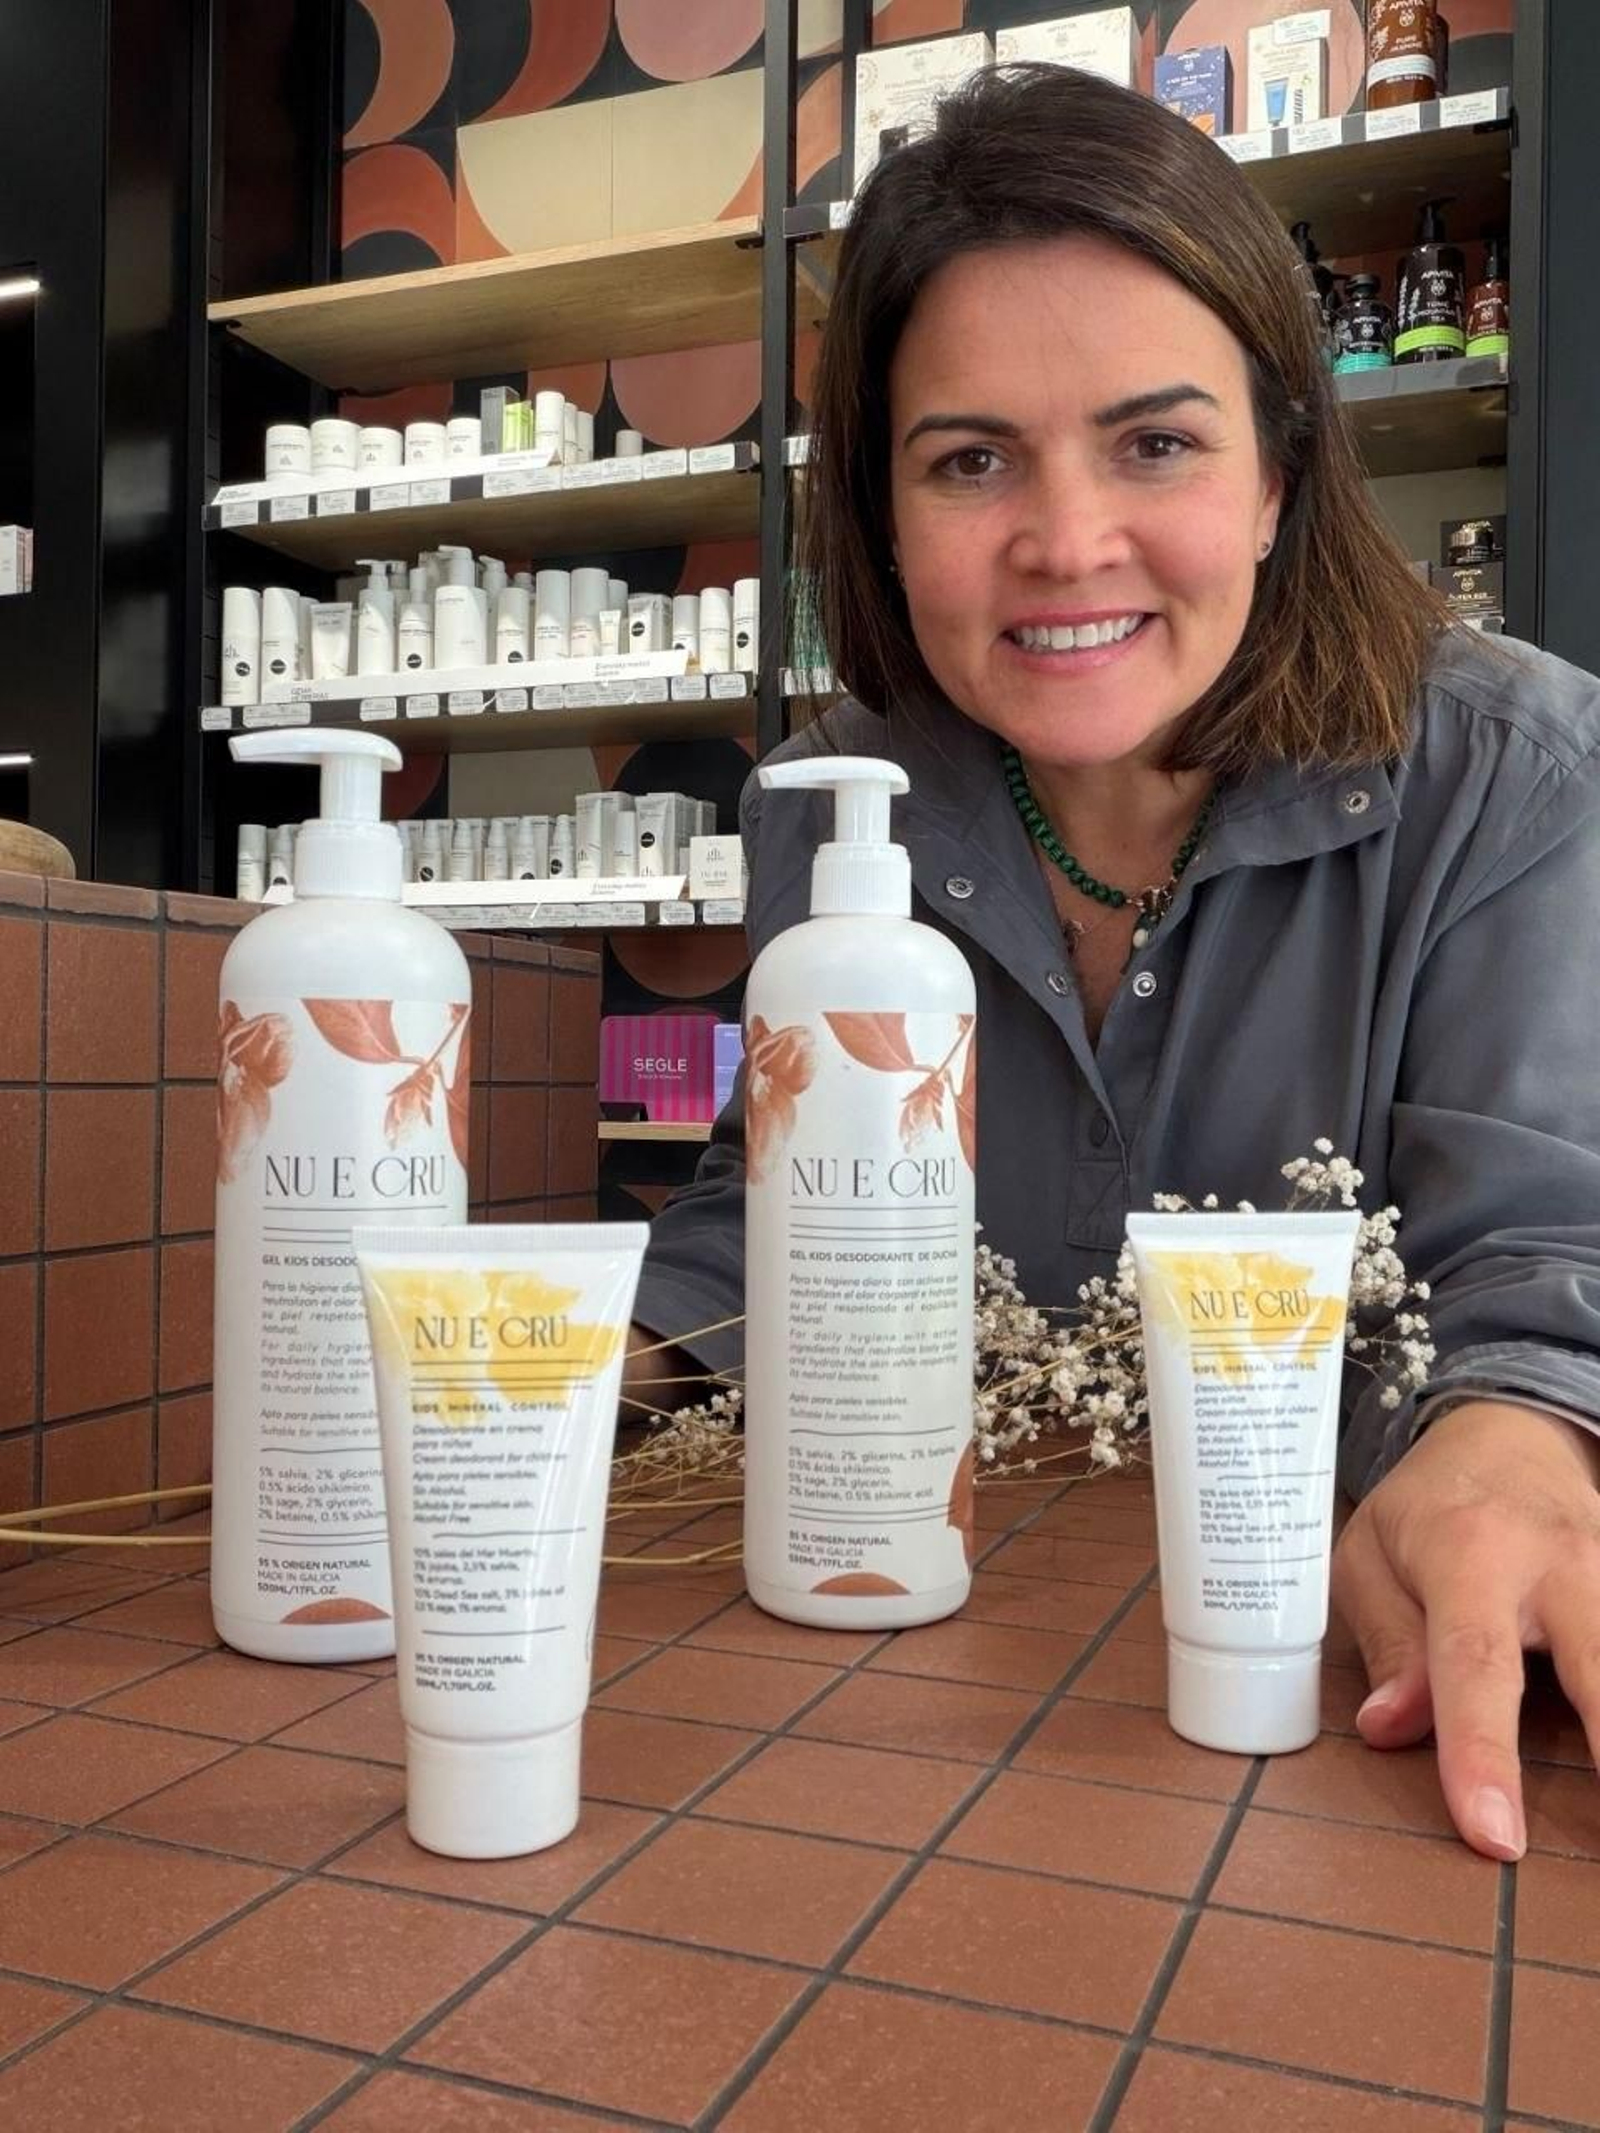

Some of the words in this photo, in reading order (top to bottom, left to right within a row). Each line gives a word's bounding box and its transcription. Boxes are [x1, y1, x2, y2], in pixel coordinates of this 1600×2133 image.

[633, 1057, 687, 1072] SEGLE
[265, 1155, 316, 1197] NU
[333, 1157, 355, 1198] E
[371, 1154, 446, 1198] CRU
[791, 1157, 838, 1197] NU
[853, 1158, 874, 1198] E
[888, 1157, 957, 1198] CRU
[262, 1254, 280, 1266] GEL
[284, 1255, 309, 1267] KIDS
[789, 1250, 807, 1261] GEL
[809, 1251, 832, 1262] KIDS
[834, 1251, 914, 1263] DESODORANTE
[917, 1251, 930, 1262] DE
[789, 1273, 811, 1284] Para
[824, 1274, 860, 1288] higiene
[897, 1276, 914, 1286] con
[1191, 1290, 1226, 1320] NU
[1232, 1290, 1249, 1319] E
[1255, 1289, 1310, 1319] CRU
[414, 1315, 459, 1350] NU
[469, 1315, 488, 1349] E
[498, 1314, 569, 1349] CRU
[448, 1402, 501, 1413] MINERAL
[511, 1401, 571, 1412] CONTROL
[412, 1424, 486, 1436] Desodorante
[489, 1424, 504, 1434] en
[506, 1424, 543, 1434] crema
[412, 1440, 438, 1451] para
[412, 1453, 446, 1465] Cream
[507, 1451, 523, 1465] for
[840, 1450, 857, 1461] 2%
[832, 1477, 848, 1487] 2%
[468, 1499, 510, 1510] sensitive
[810, 1533, 846, 1545] ORIGEN
[848, 1534, 893, 1545] NATURAL
[788, 1542, 811, 1553] MADE
[814, 1545, 824, 1554] IN
[826, 1547, 864, 1557] GALICIA
[281, 1559, 320, 1571] ORIGEN
[322, 1559, 372, 1571] NATURAL
[257, 1571, 283, 1581] MADE
[286, 1572, 297, 1582] IN
[300, 1573, 340, 1583] GALICIA
[1225, 1579, 1260, 1589] ORIGEN
[1203, 1589, 1229, 1599] MADE
[437, 1654, 475, 1666] ORIGEN
[477, 1654, 526, 1665] NATURAL
[454, 1667, 495, 1678] GALICIA
